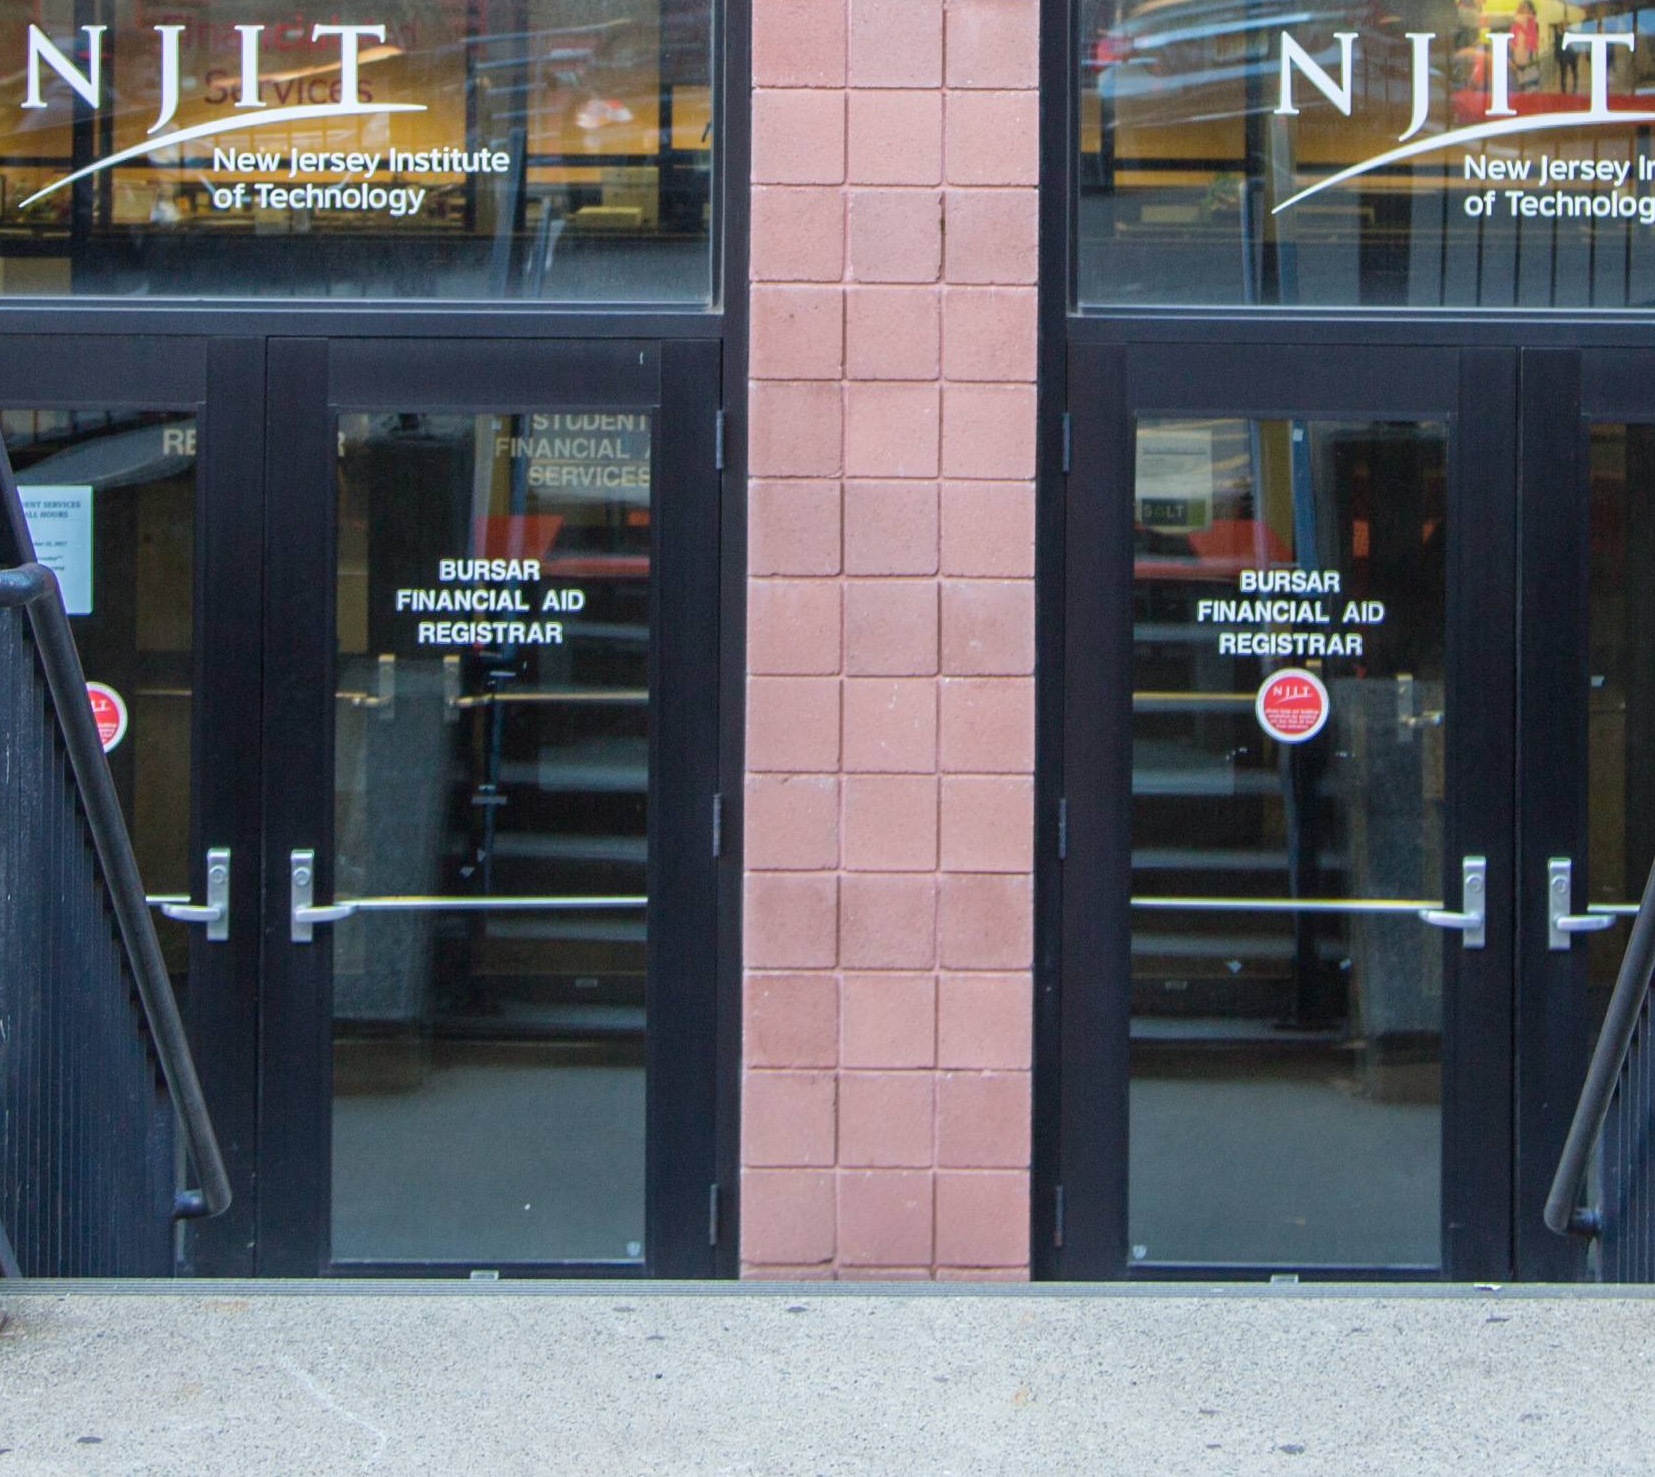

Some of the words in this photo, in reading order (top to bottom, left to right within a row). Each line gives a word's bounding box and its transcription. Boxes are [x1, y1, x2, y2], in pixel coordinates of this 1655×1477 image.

[20, 23, 386, 135] NJIT
[1273, 30, 1636, 143] NJIT
[213, 148, 281, 173] New
[288, 147, 381, 179] Jersey
[389, 147, 509, 172] Institute
[1464, 155, 1532, 181] New
[1539, 155, 1630, 187] Jersey
[214, 184, 245, 208] of
[255, 183, 426, 216] Technology
[1465, 190, 1495, 215] of
[496, 436, 631, 459] FINANCIAL
[528, 465, 651, 487] SERVICES
[440, 559, 540, 580] BURSAR
[1242, 571, 1339, 591] BURSAR
[398, 590, 529, 610] FINANCIAL
[543, 590, 583, 610] AID
[1198, 601, 1329, 621] FINANCIAL
[1343, 602, 1383, 622] AID
[419, 623, 561, 643] REGISTRAR
[1220, 633, 1362, 654] REGISTRAR
